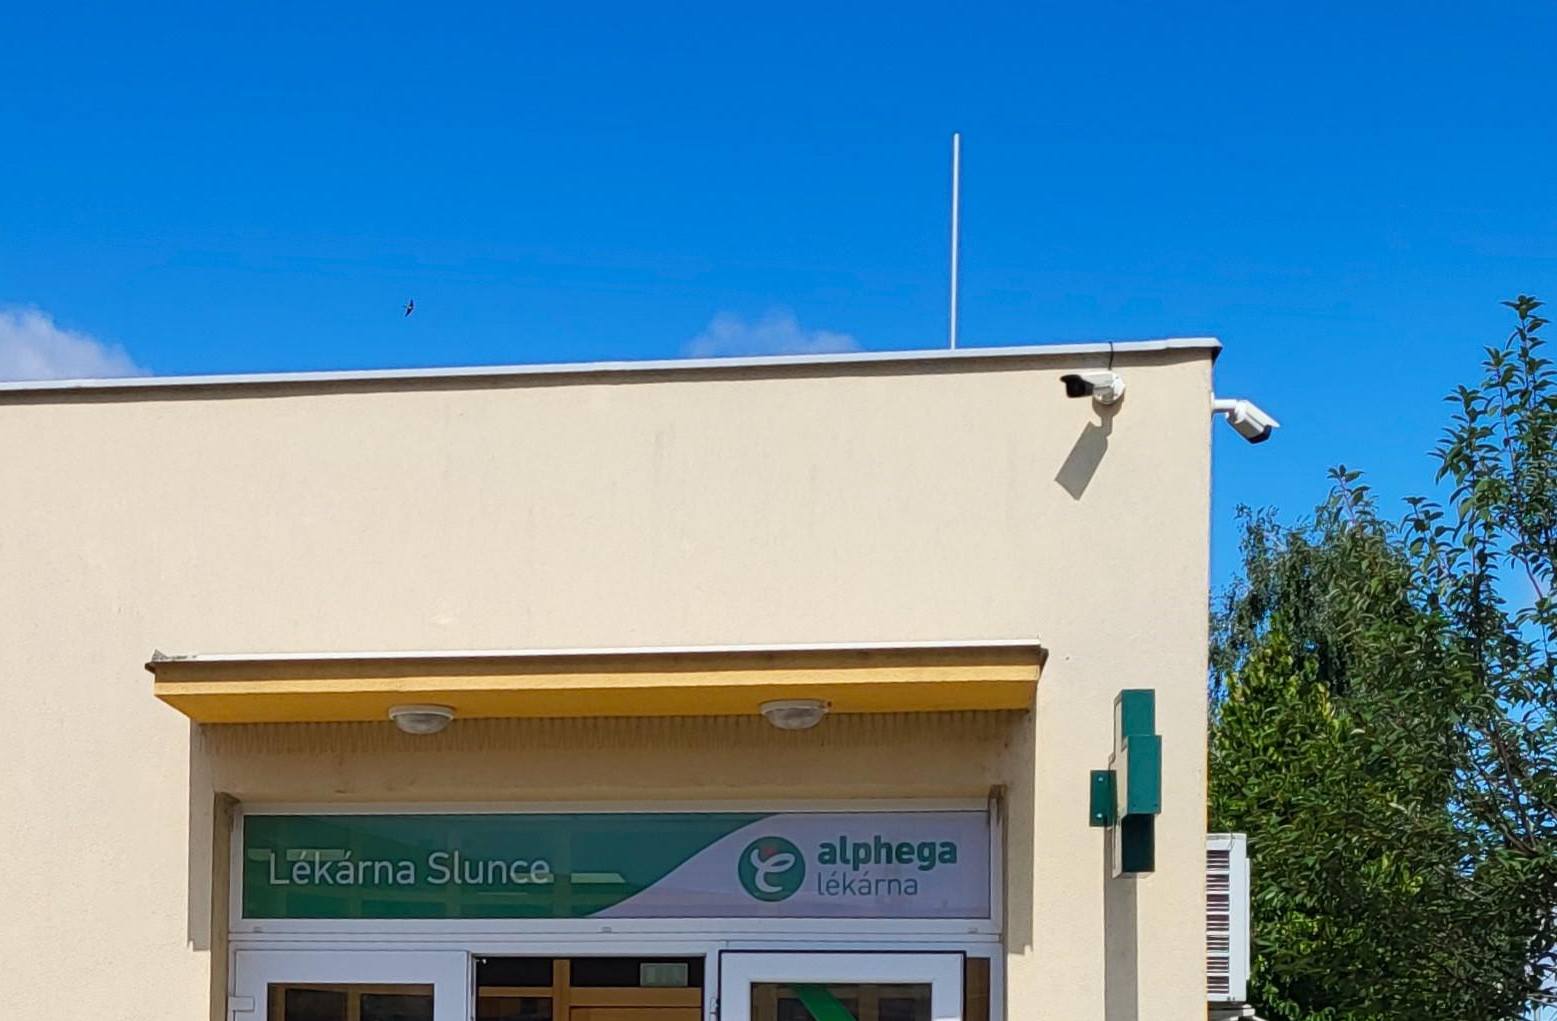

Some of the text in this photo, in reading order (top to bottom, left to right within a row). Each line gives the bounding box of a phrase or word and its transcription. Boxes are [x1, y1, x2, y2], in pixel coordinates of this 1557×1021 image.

[269, 851, 550, 884] Lékárna Slunce
[817, 835, 957, 871] alphega
[817, 870, 918, 896] lékárna
